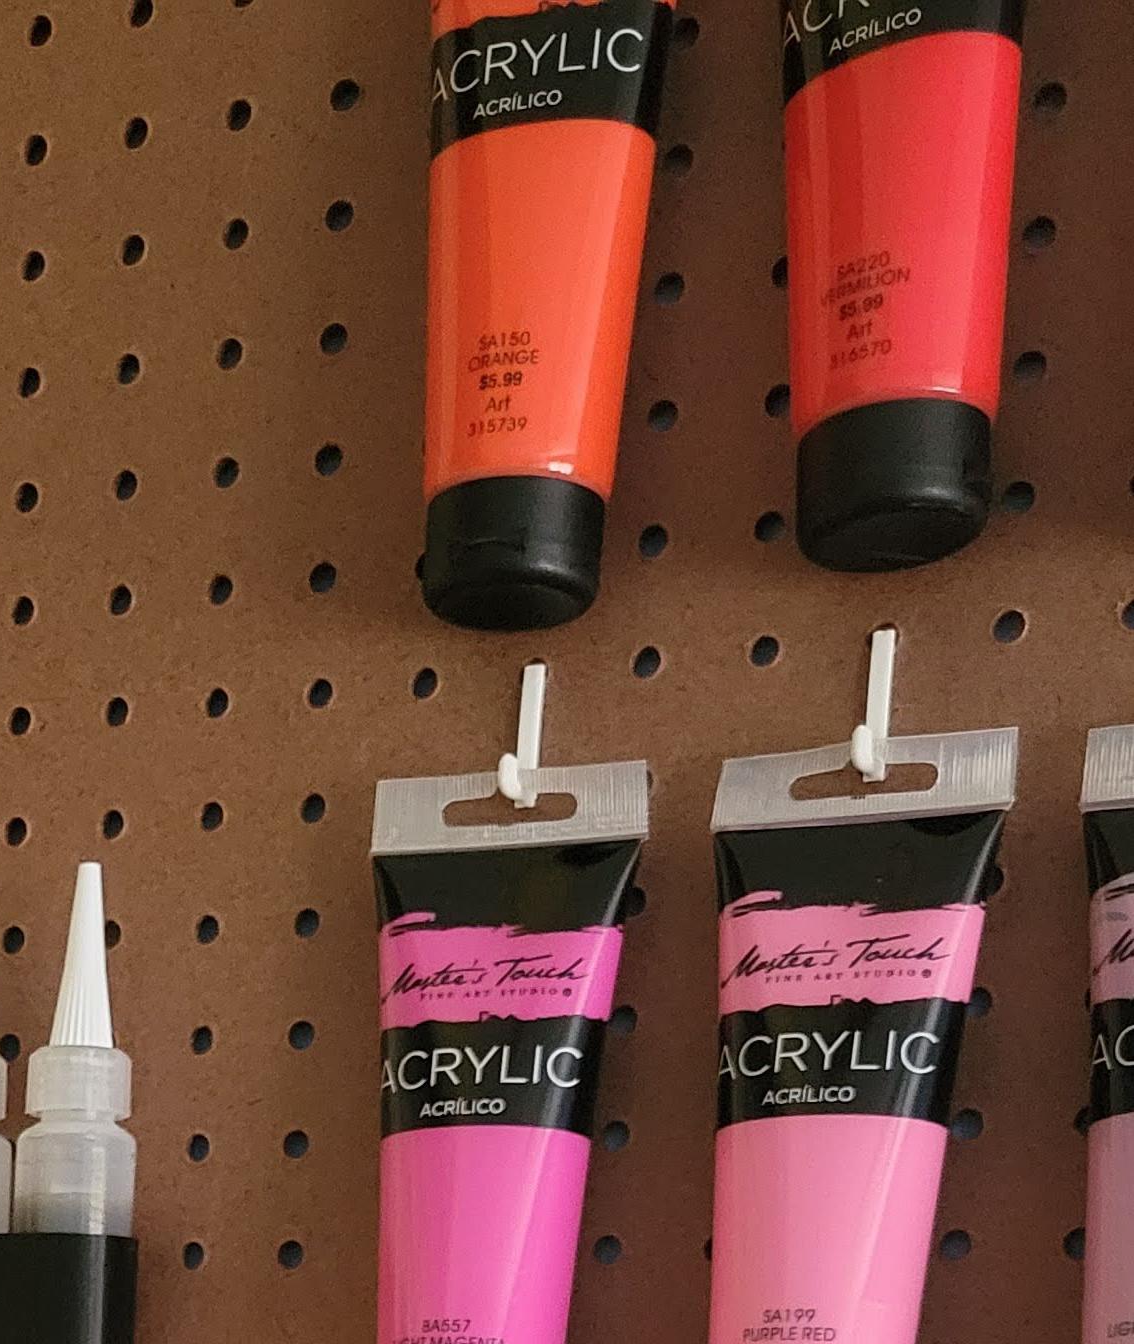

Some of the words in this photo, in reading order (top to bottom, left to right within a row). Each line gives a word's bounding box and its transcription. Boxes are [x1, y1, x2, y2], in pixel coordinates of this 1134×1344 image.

[828, 8, 922, 55] ACRÍLICO
[432, 28, 644, 100] ACRYLIC
[472, 89, 563, 120] ACRÍLICO
[467, 349, 540, 372] ORANGE
[478, 371, 523, 390] $5.99
[485, 395, 512, 413] Art
[721, 940, 843, 989] Master's
[846, 933, 951, 968] Touch
[381, 959, 490, 1003] Master's
[494, 954, 588, 987] Touch
[718, 1029, 940, 1080] ACRYLIC
[380, 1044, 584, 1095] ACRYLIC
[419, 1096, 507, 1119] ACRÍLICO
[761, 1083, 856, 1106] ACRÍLICO
[762, 1309, 816, 1324] SA199
[743, 1327, 797, 1342] PURPLE
[801, 1327, 836, 1342] RED
